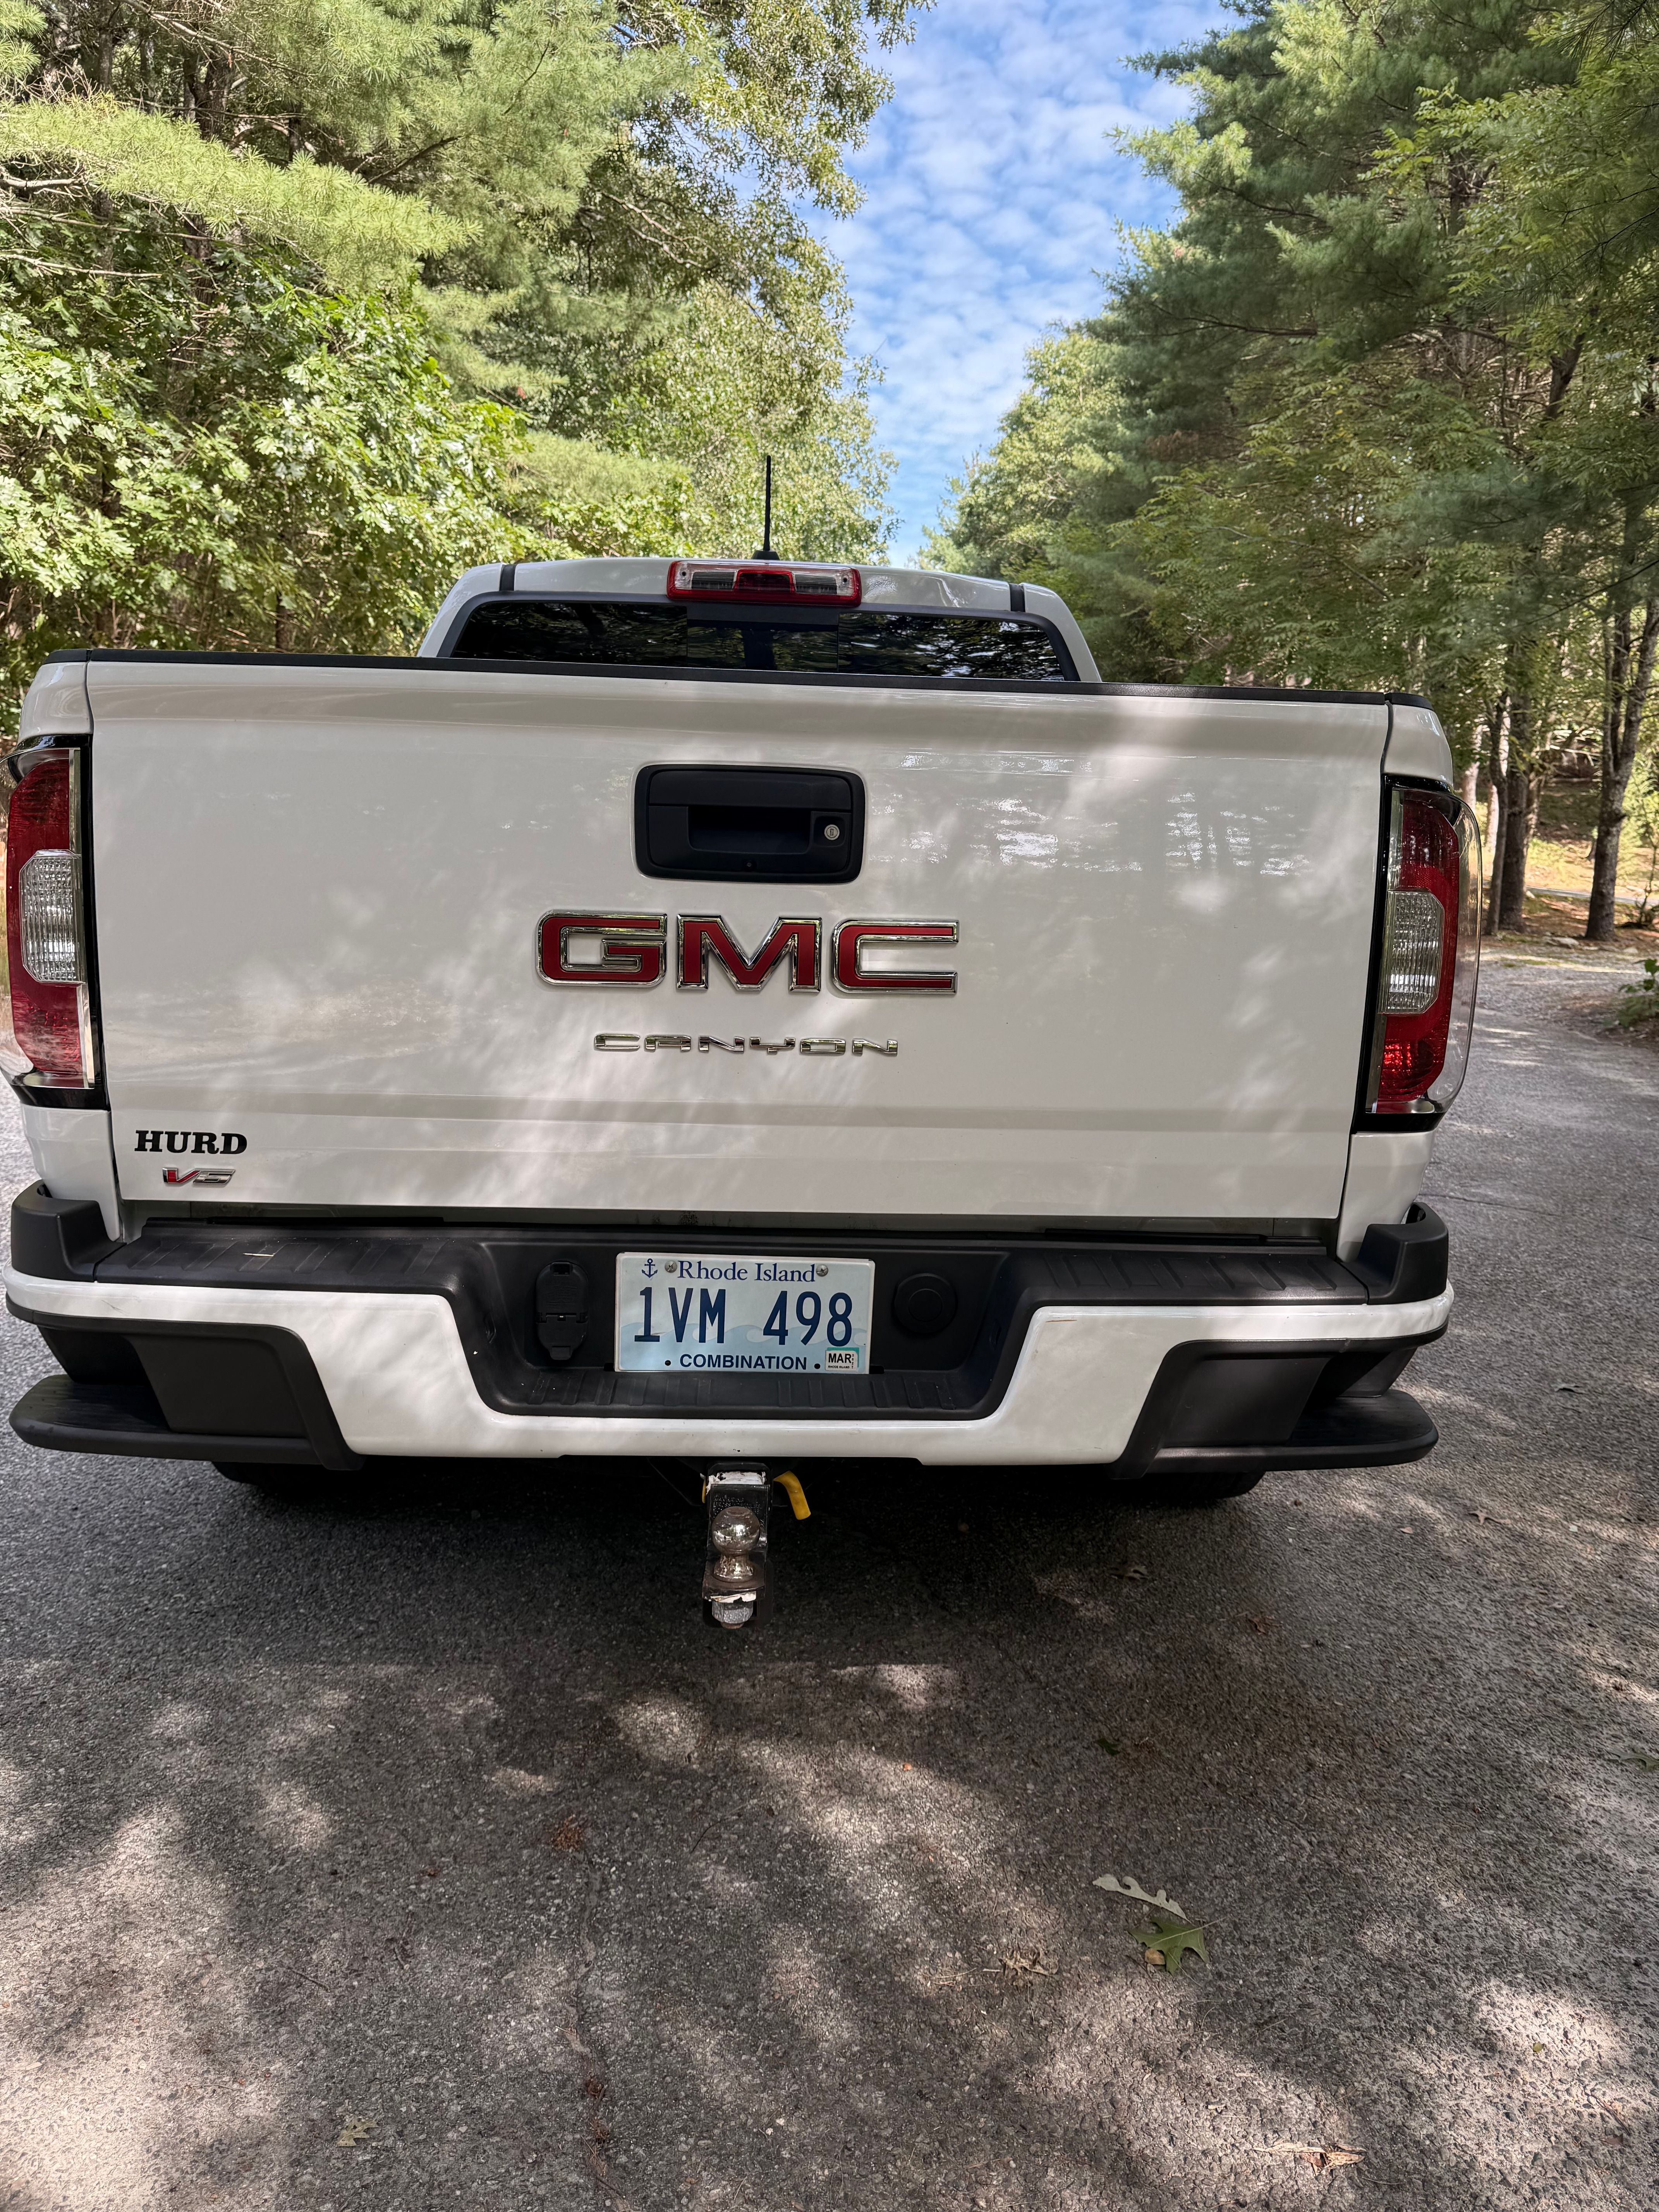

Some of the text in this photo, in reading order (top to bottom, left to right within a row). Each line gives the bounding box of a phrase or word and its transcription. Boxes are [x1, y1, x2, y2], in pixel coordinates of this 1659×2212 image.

[536, 909, 959, 994] GMC
[594, 1033, 898, 1057] CANYON
[134, 1130, 247, 1154] HURD
[162, 1167, 236, 1184] V6
[677, 1260, 816, 1282] Rhode Island
[634, 1286, 726, 1344] 1VM
[763, 1290, 852, 1347] 498
[680, 1353, 807, 1370] COMBINATION
[829, 1353, 851, 1363] MAR
